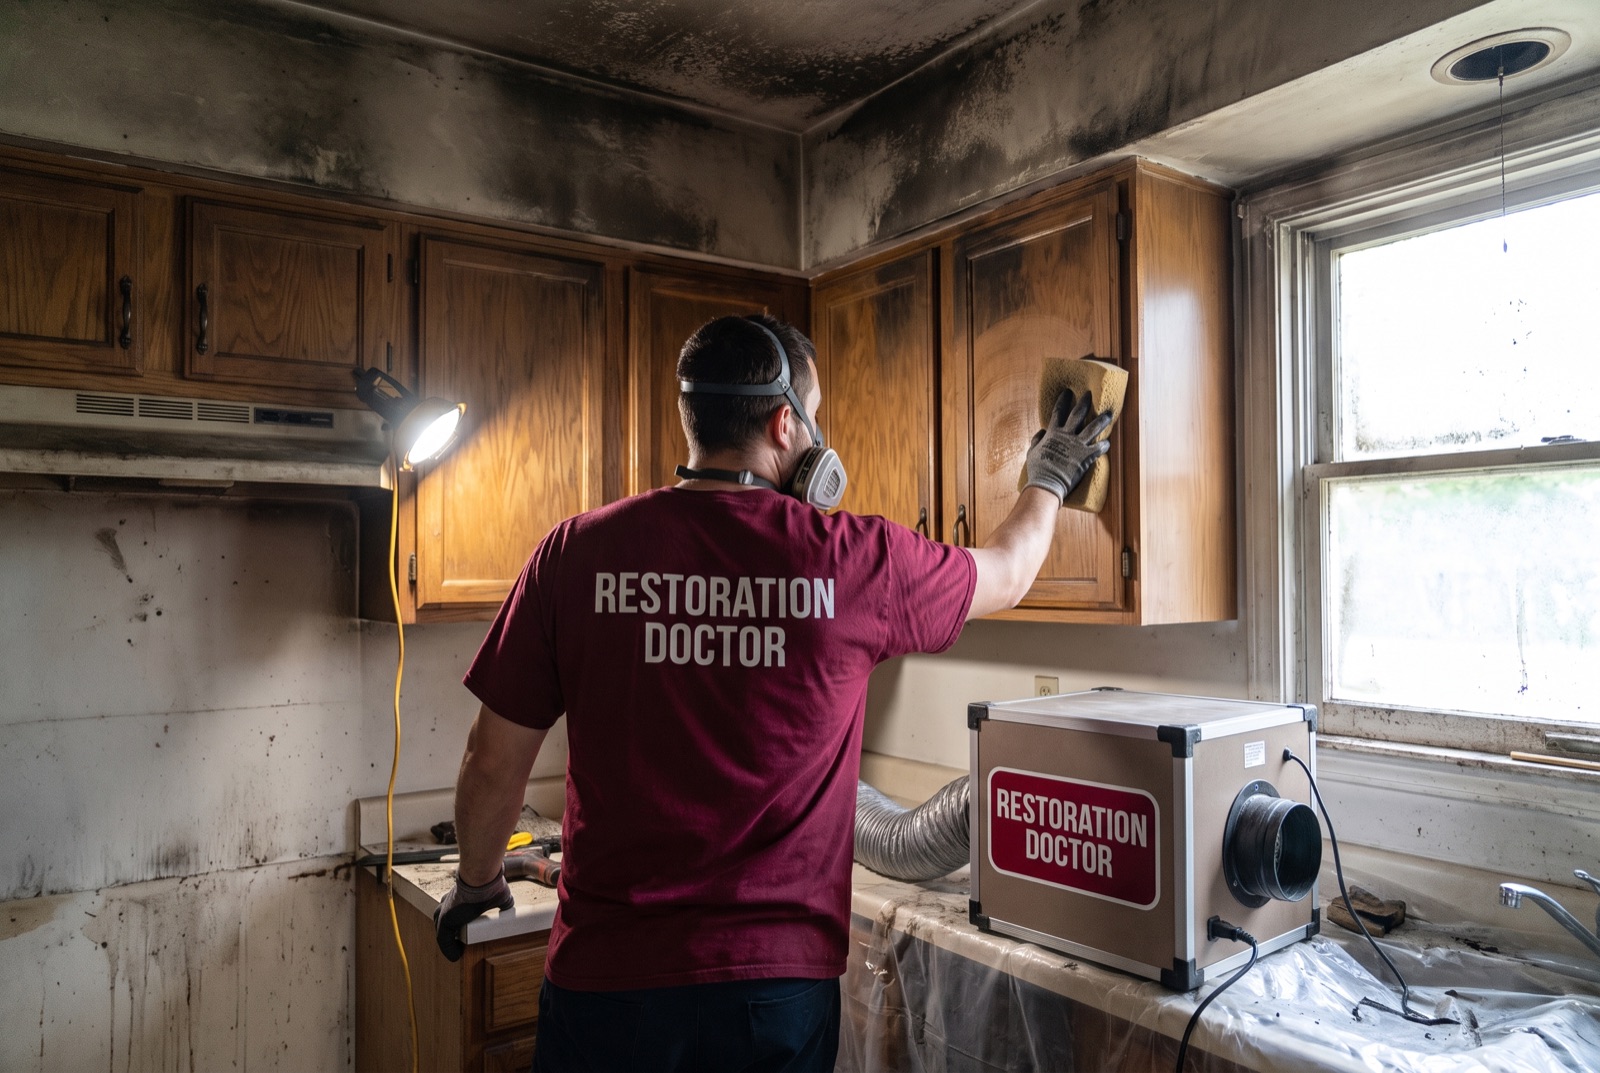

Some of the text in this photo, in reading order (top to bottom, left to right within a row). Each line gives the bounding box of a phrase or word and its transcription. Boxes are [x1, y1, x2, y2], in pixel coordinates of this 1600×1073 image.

[594, 572, 835, 619] RESTORATION
[644, 622, 786, 667] DOCTOR
[996, 788, 1148, 848] RESTORATION
[1025, 828, 1113, 878] DOCTOR
